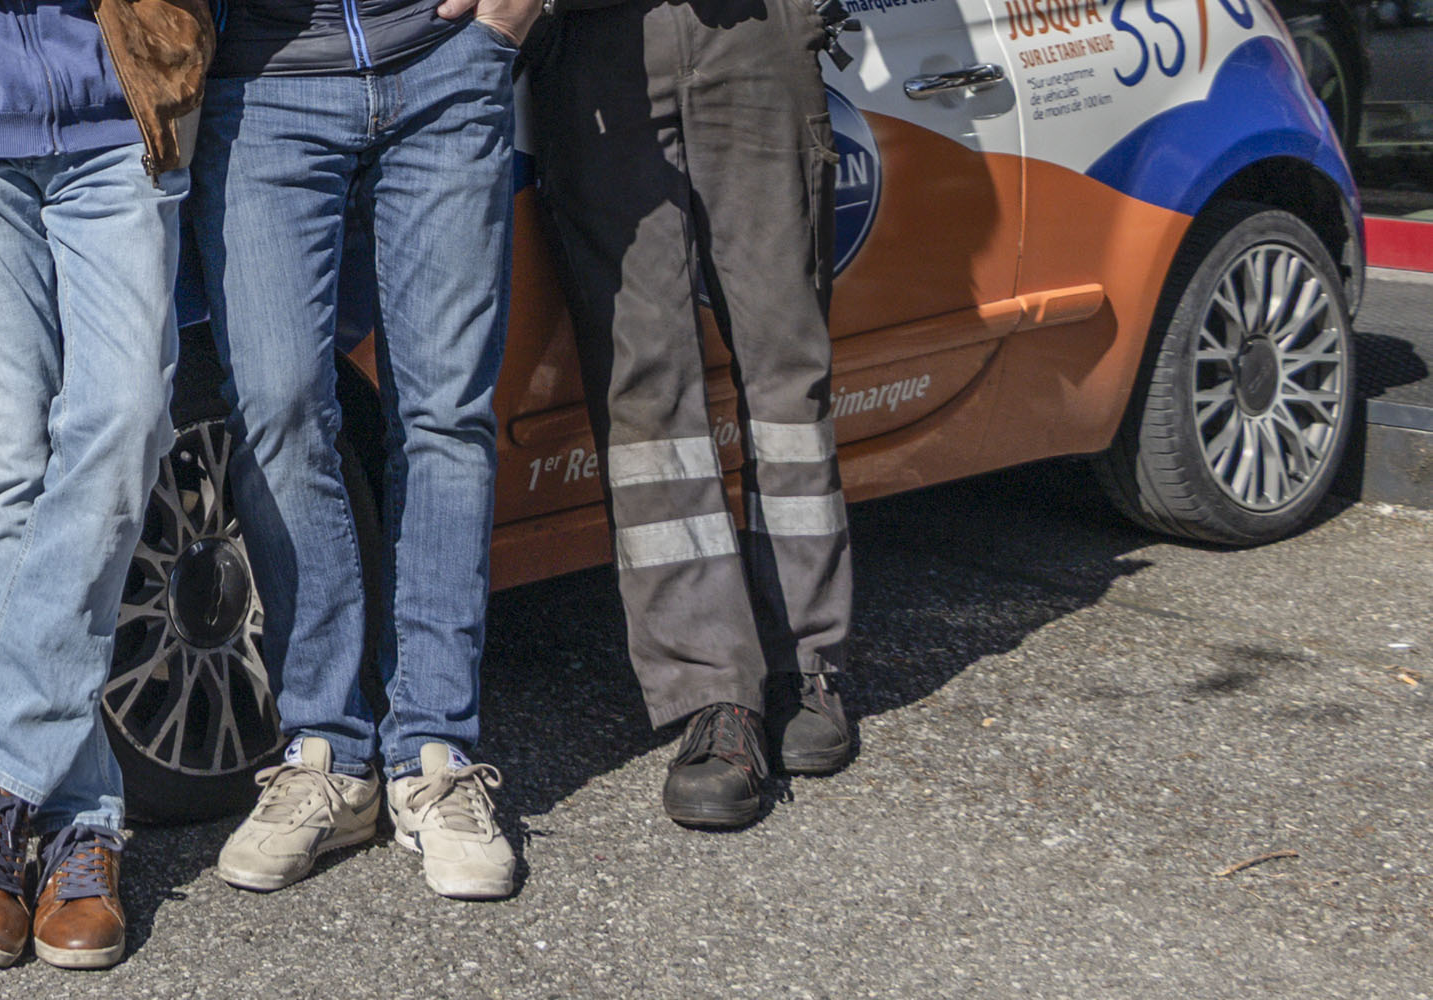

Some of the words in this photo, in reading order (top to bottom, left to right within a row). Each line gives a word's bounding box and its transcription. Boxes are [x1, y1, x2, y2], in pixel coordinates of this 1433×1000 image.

[1019, 48, 1044, 69] SUR
[1042, 46, 1058, 63] LE
[1055, 39, 1087, 61] TARIF
[1086, 34, 1115, 55] NEUF
[831, 374, 930, 419] imarque
[529, 455, 562, 491] 1er
